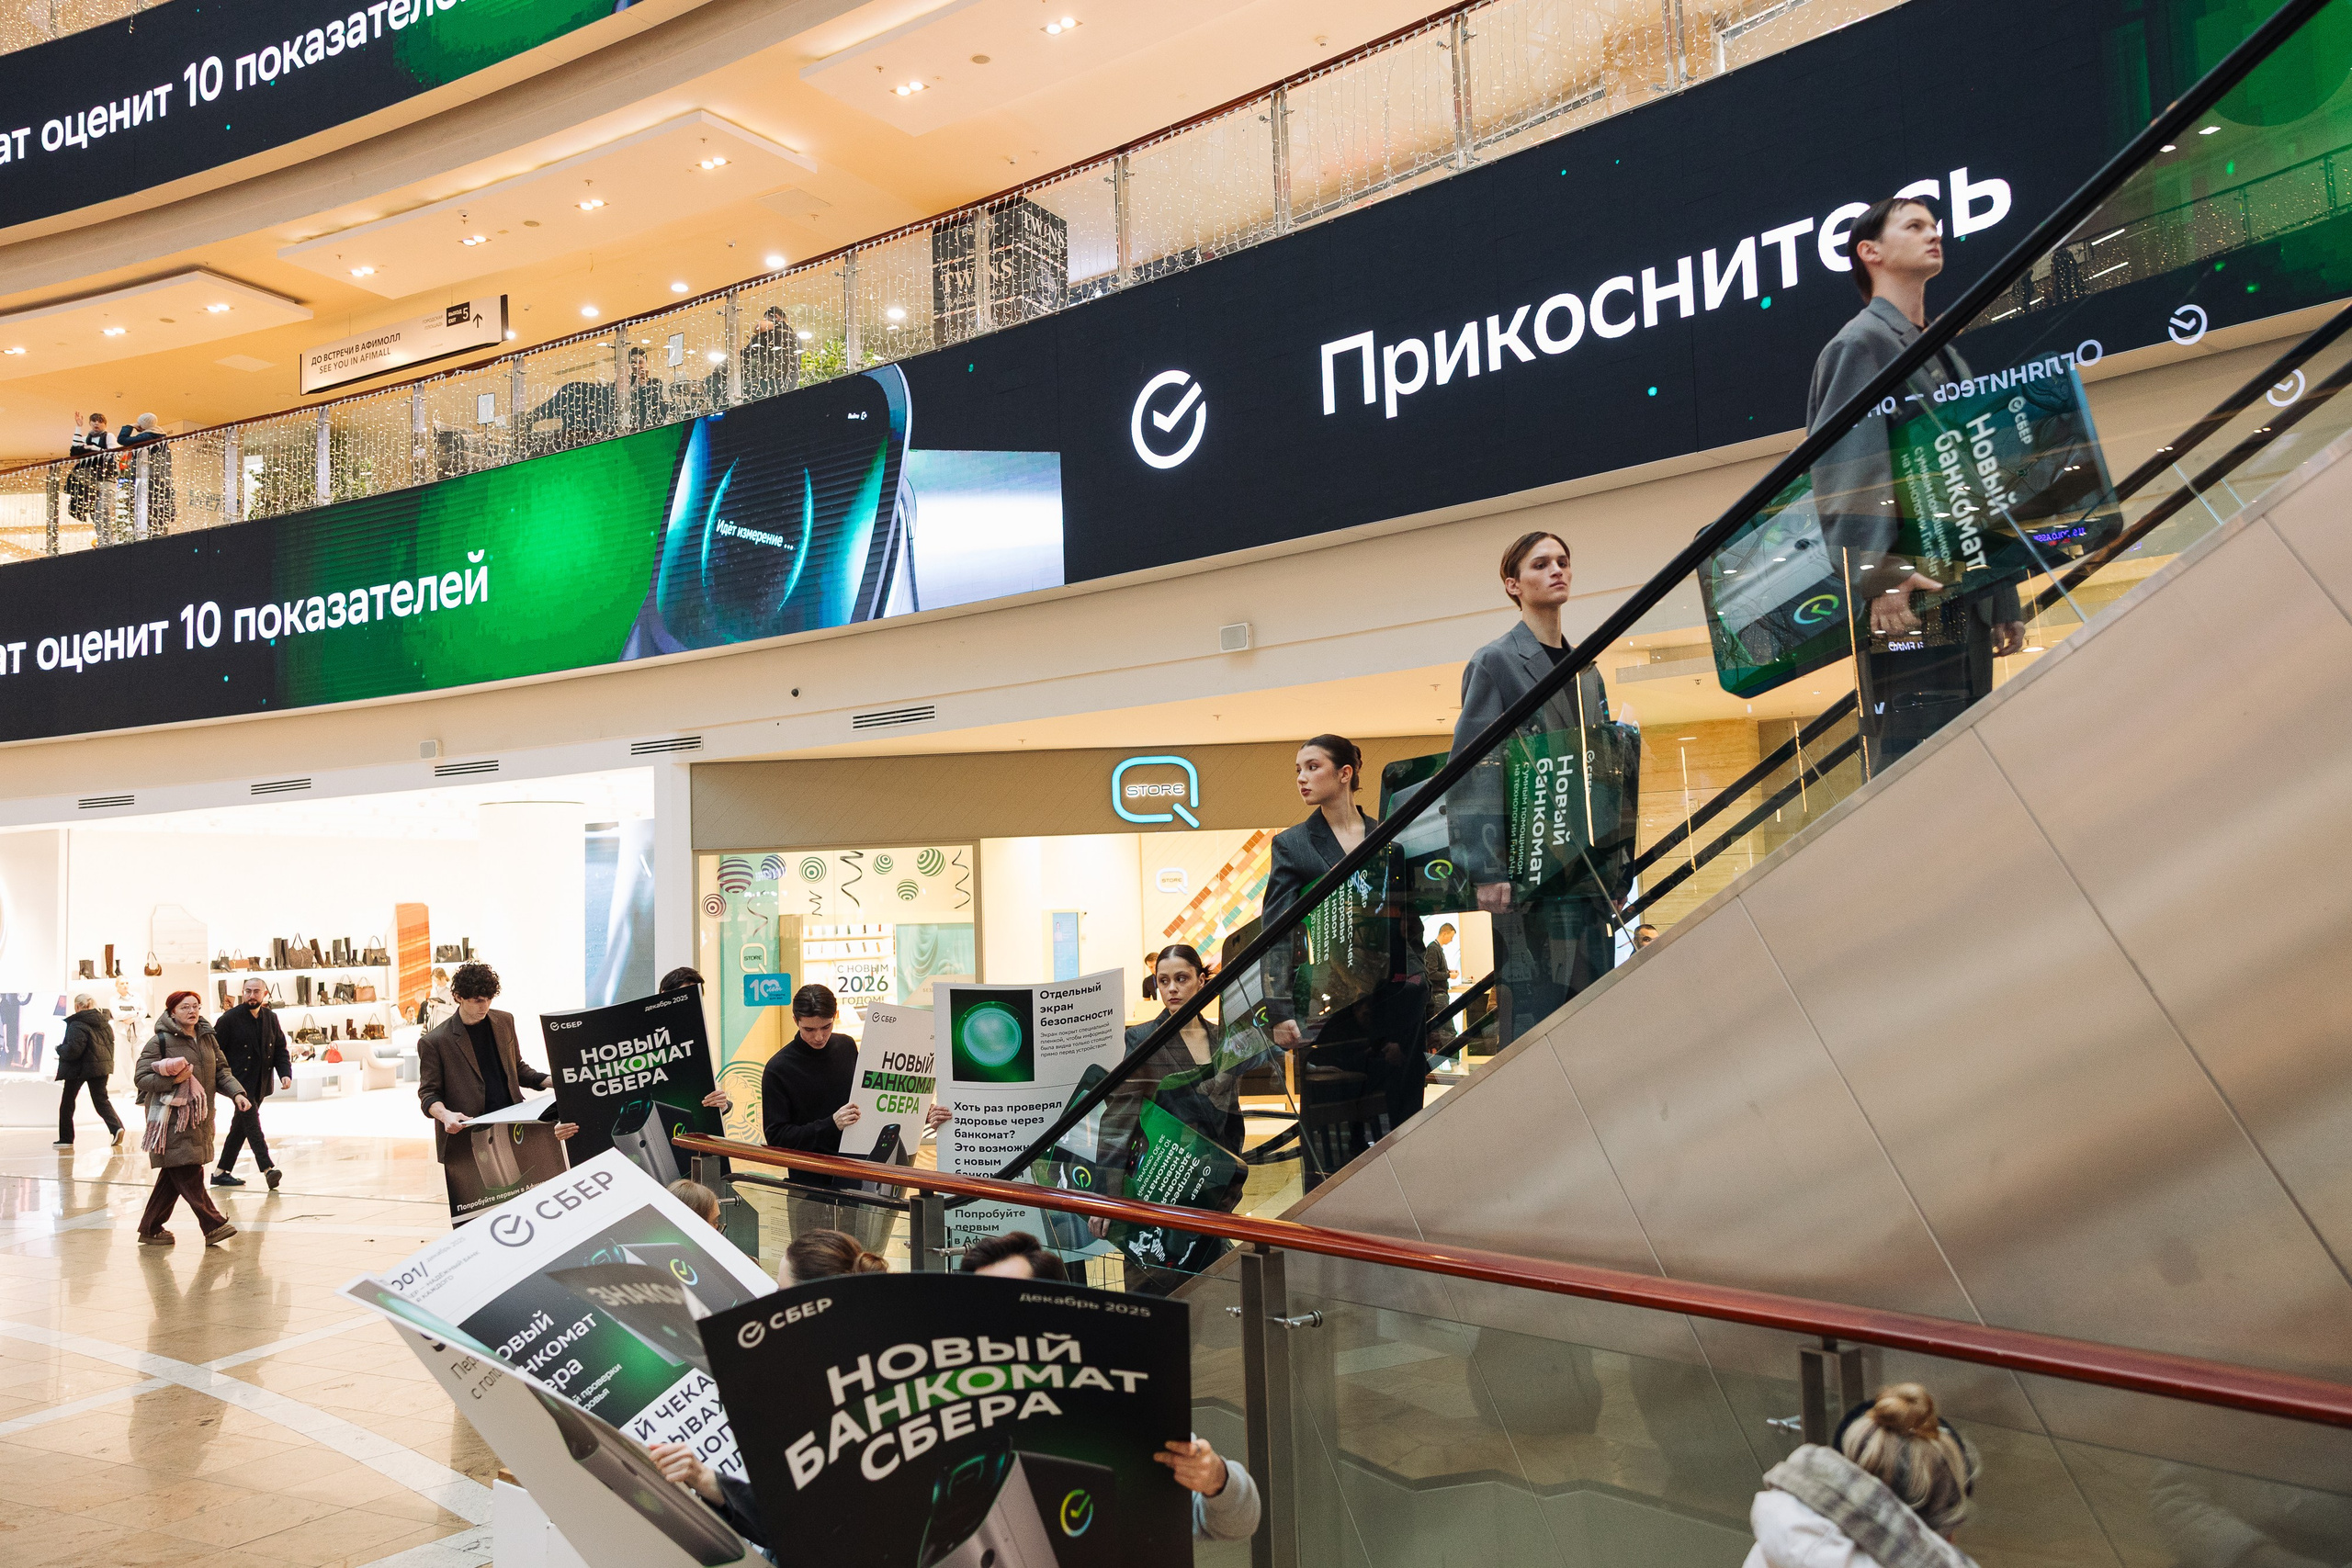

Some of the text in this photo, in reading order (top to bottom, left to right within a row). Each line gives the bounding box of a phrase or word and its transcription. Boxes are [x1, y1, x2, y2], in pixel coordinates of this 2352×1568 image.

[41, 83, 173, 149] оценит
[184, 56, 223, 107] 10
[235, 0, 466, 91] показател
[940, 258, 1012, 294] TWNS
[463, 308, 469, 320] 5
[311, 333, 401, 367] ДО ВСТРЕЧИ В АФИМОЛЛ
[320, 347, 390, 374] SEE YOU IN AFIMALL
[2013, 412, 2033, 446] СБЕР
[1901, 453, 1911, 469] на
[1913, 454, 1931, 492] умным
[1966, 412, 2018, 516] Новый
[1934, 429, 1987, 568] банкомат
[716, 519, 784, 547] Идёт измерение
[37, 621, 169, 673] оценит
[181, 602, 221, 650] 10
[234, 549, 488, 642] показателей
[1514, 764, 1521, 776] на
[1126, 784, 1184, 796] STORE
[1553, 754, 1574, 845] Новый
[1511, 779, 1520, 837] технологии
[1529, 758, 1554, 885] банкомат
[1517, 807, 1526, 874] помощником
[846, 964, 888, 973] НОВЫМ
[838, 976, 888, 993] 2026
[1040, 982, 1101, 999] Отдельный
[644, 994, 688, 1011] декабрь 2025
[842, 997, 885, 1006] ГОДОМ!
[1040, 1003, 1073, 1014] экран
[560, 1021, 582, 1029] СБЕР
[881, 1015, 897, 1023] СБЕР
[1040, 1009, 1113, 1027] безопасности
[1079, 1021, 1109, 1033] специальной
[581, 1027, 671, 1065] НОВЫЙ
[1083, 1029, 1112, 1038] информация
[1091, 1035, 1113, 1043] стоящему
[562, 1040, 695, 1084] БАНКОМАТ
[882, 1051, 934, 1074] НОВЫЙ
[592, 1066, 669, 1097] СБЕРА
[862, 1071, 936, 1094] БАНКОМАТ
[876, 1094, 919, 1114] СБЕРА
[955, 1101, 1062, 1114] Хоть раз проверял
[955, 1117, 1044, 1127] здоровье через
[955, 1129, 1015, 1139] банкомат?
[955, 1143, 1029, 1153] Это возможн
[1136, 1134, 1165, 1182] за 30 секунд
[1136, 1138, 1170, 1196] 10 показателей
[1142, 1142, 1179, 1201] банкомате
[1157, 1146, 1184, 1191] в новом
[1159, 1151, 1193, 1204] здоровья
[1170, 1156, 1200, 1205] Экспрес
[457, 1196, 495, 1212] Попробуйте
[497, 1189, 520, 1200] первым
[536, 1171, 613, 1220] СБЕР
[1191, 1177, 1204, 1201] СБЕР
[956, 1209, 1025, 1220] Попробуйте
[769, 1297, 833, 1330] СБЕР
[1018, 1291, 1151, 1317] декабрь 2025
[496, 1310, 555, 1360] овый
[519, 1313, 597, 1374] нкомат
[581, 1363, 623, 1399] проверки
[826, 1332, 1082, 1406] НОВЫЙ
[784, 1363, 1149, 1492] БАНКОМАТ
[860, 1392, 1063, 1482] СБЕРА
